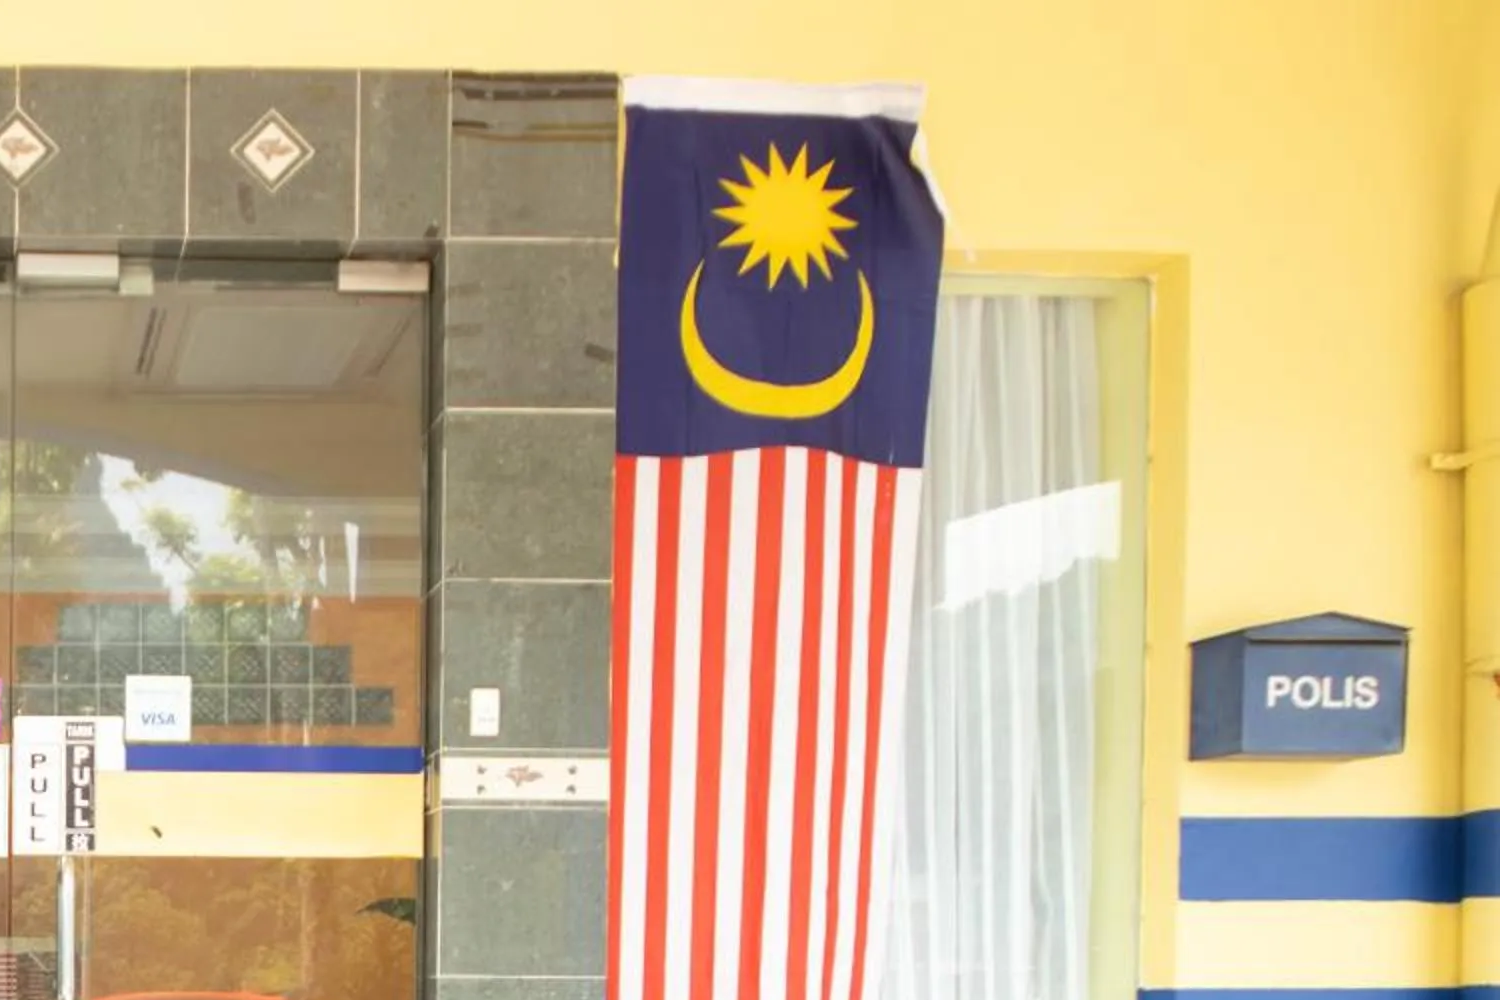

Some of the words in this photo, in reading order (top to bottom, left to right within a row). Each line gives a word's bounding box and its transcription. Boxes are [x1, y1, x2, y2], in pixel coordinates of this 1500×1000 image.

[141, 711, 177, 726] VISA
[1266, 675, 1380, 709] POLIS
[30, 753, 47, 841] PULL
[73, 745, 90, 827] PULL
